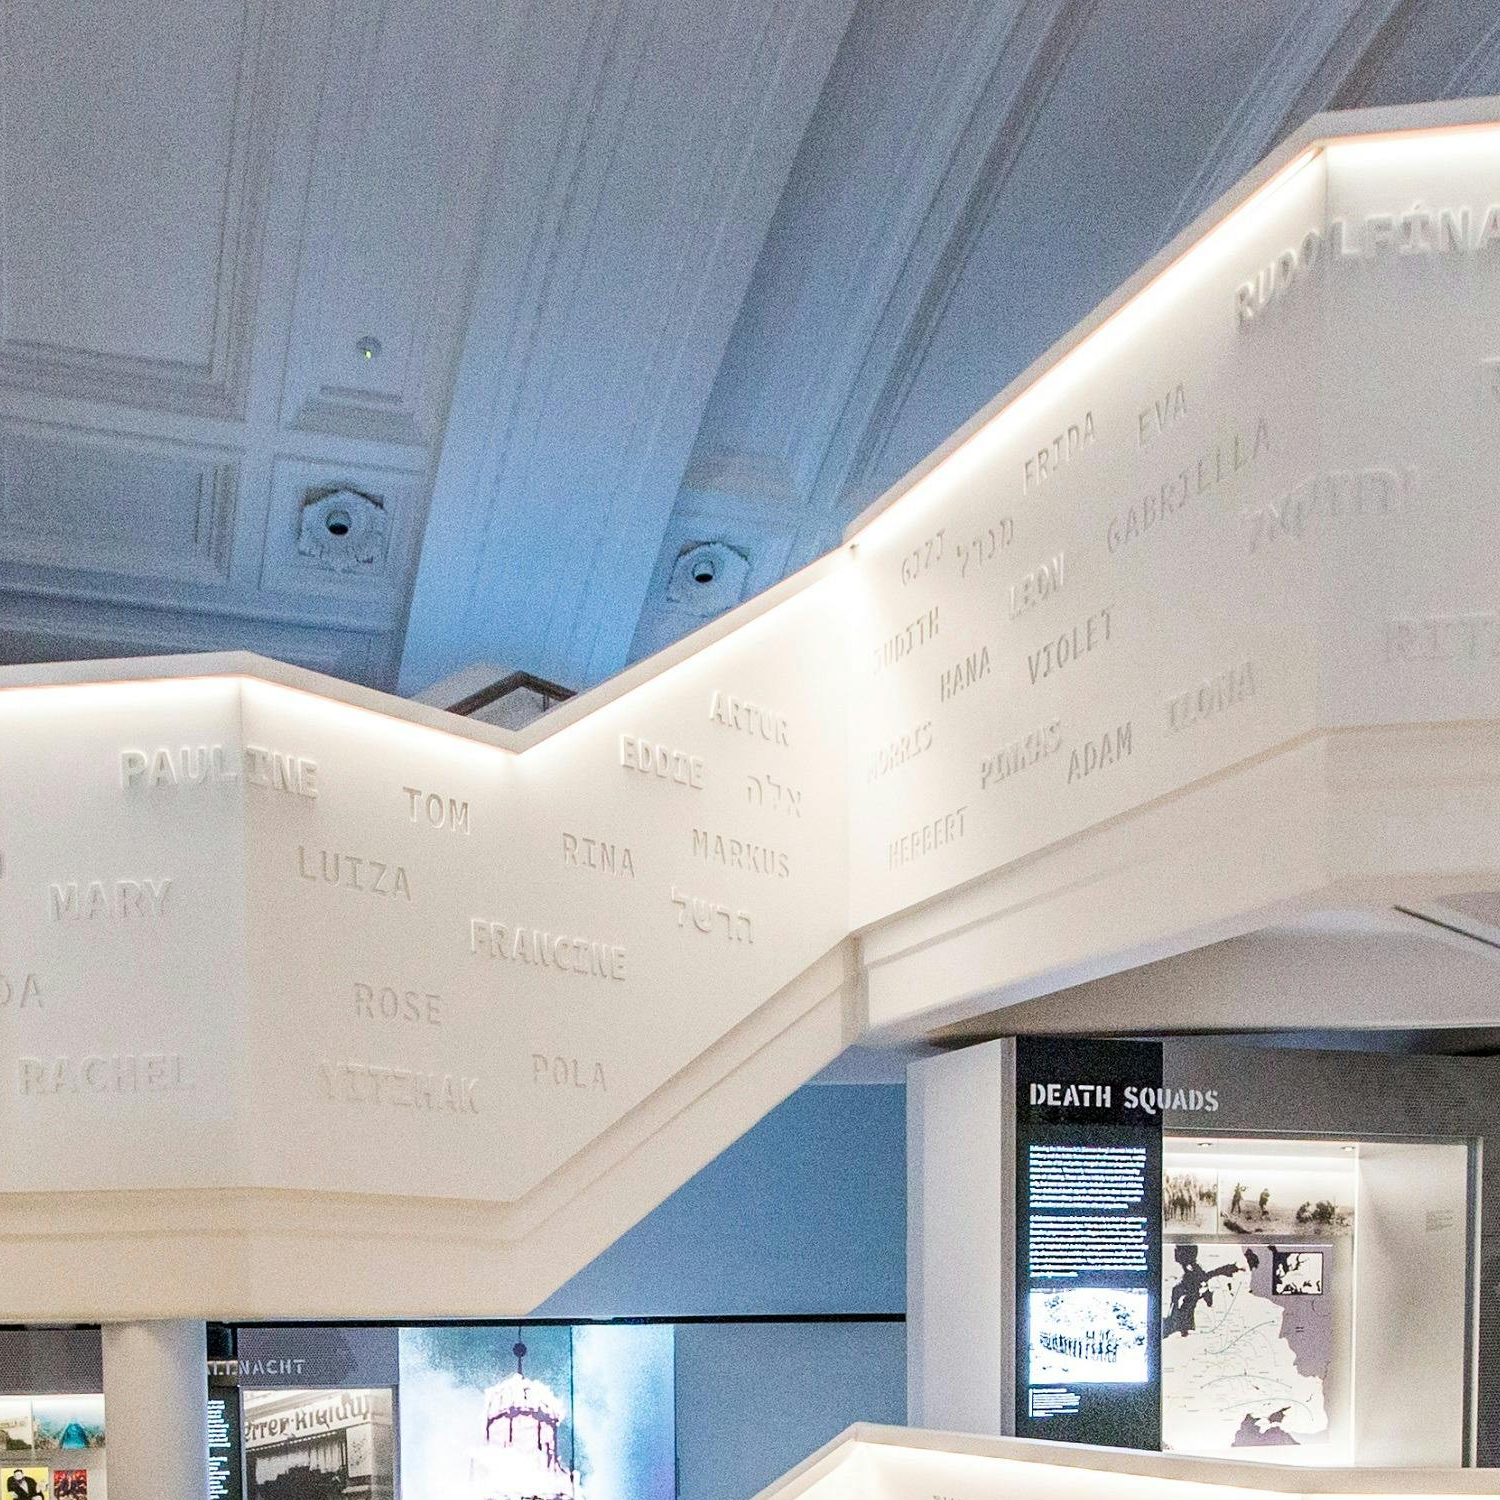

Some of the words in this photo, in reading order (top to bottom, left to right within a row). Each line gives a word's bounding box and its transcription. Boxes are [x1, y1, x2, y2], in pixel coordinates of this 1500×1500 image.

[1136, 382, 1190, 446] EVA
[1021, 411, 1097, 494] FRIDA
[1105, 416, 1273, 554] GABRIELLA
[1009, 550, 1067, 622] LEON
[1026, 603, 1117, 685] VIOLET
[938, 645, 992, 703] HANA
[708, 690, 792, 748] ARTUR
[118, 745, 320, 803] PAULINE
[618, 733, 705, 794] EDDIE
[1066, 721, 1135, 785] ADAM
[401, 786, 472, 836] TOM
[887, 805, 969, 870] HERBERT
[296, 845, 412, 901] LUIZA
[560, 831, 637, 879] RINA
[691, 827, 792, 879] MARKUS
[48, 876, 176, 922] MARY
[468, 915, 627, 984] FRANCINE
[353, 982, 443, 1026] ROSE
[18, 1052, 199, 1096] RACHEL
[530, 1051, 608, 1094] POLA
[1029, 1083, 1112, 1108] DEATH
[1123, 1084, 1220, 1116] SQUADS
